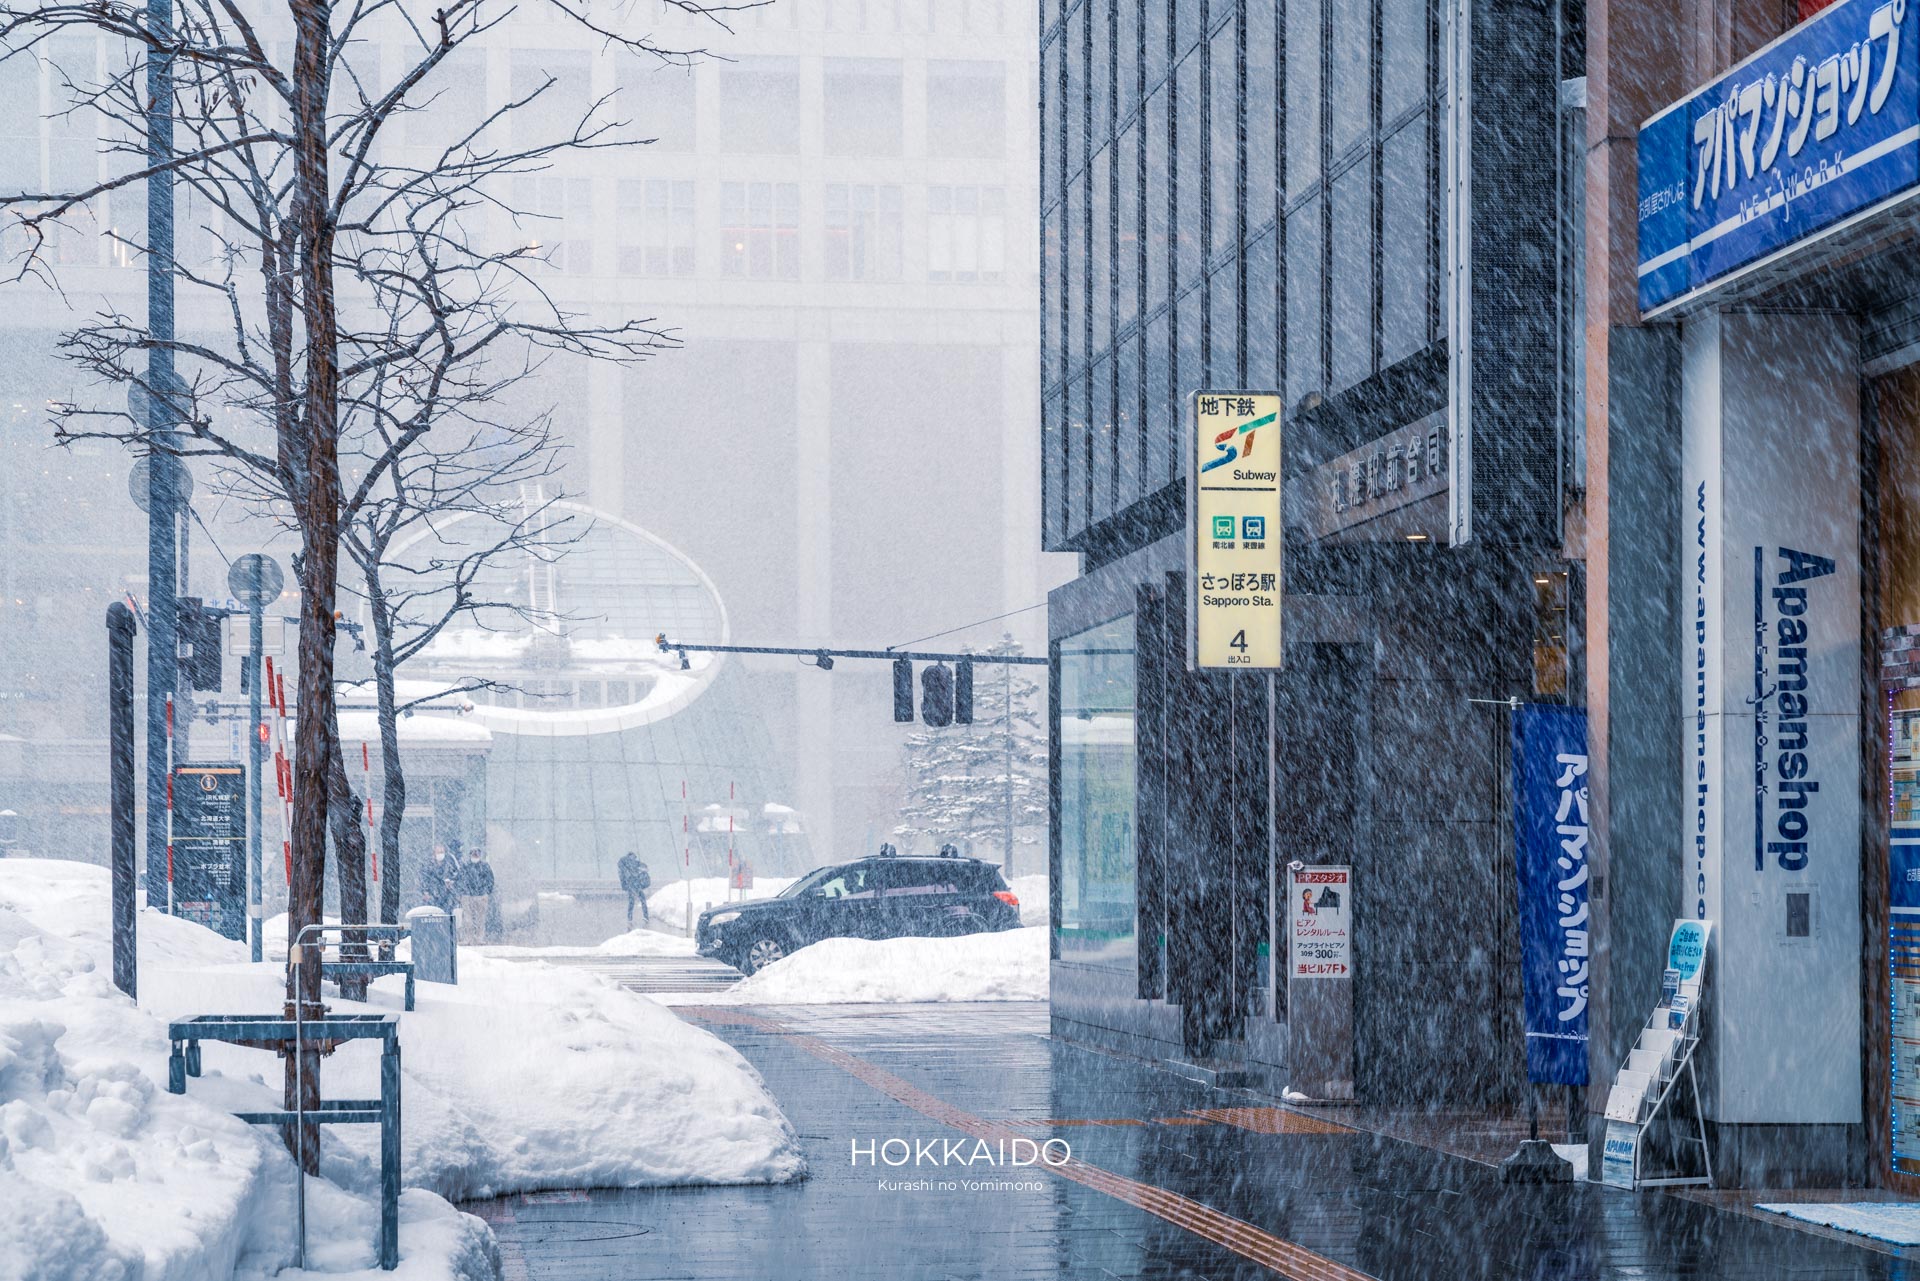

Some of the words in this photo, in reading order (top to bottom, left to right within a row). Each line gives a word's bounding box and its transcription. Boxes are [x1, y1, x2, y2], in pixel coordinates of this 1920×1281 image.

[1694, 0, 1905, 210] アパマンショップ
[1638, 179, 1684, 222] お部屋さがしは
[1201, 397, 1255, 417] 地下鉄
[1233, 469, 1276, 481] Subway
[1201, 572, 1276, 592] さっぽろ駅
[1203, 595, 1250, 607] Sapporo
[1253, 595, 1274, 606] Sta.
[1229, 629, 1248, 653] 4
[1227, 655, 1251, 664] 出入口
[1767, 546, 1836, 872] Apamanshop
[1555, 753, 1588, 1021] アパマンショップ
[1296, 928, 1346, 937] レンタルルーム
[1297, 963, 1339, 974] 当ビル7F
